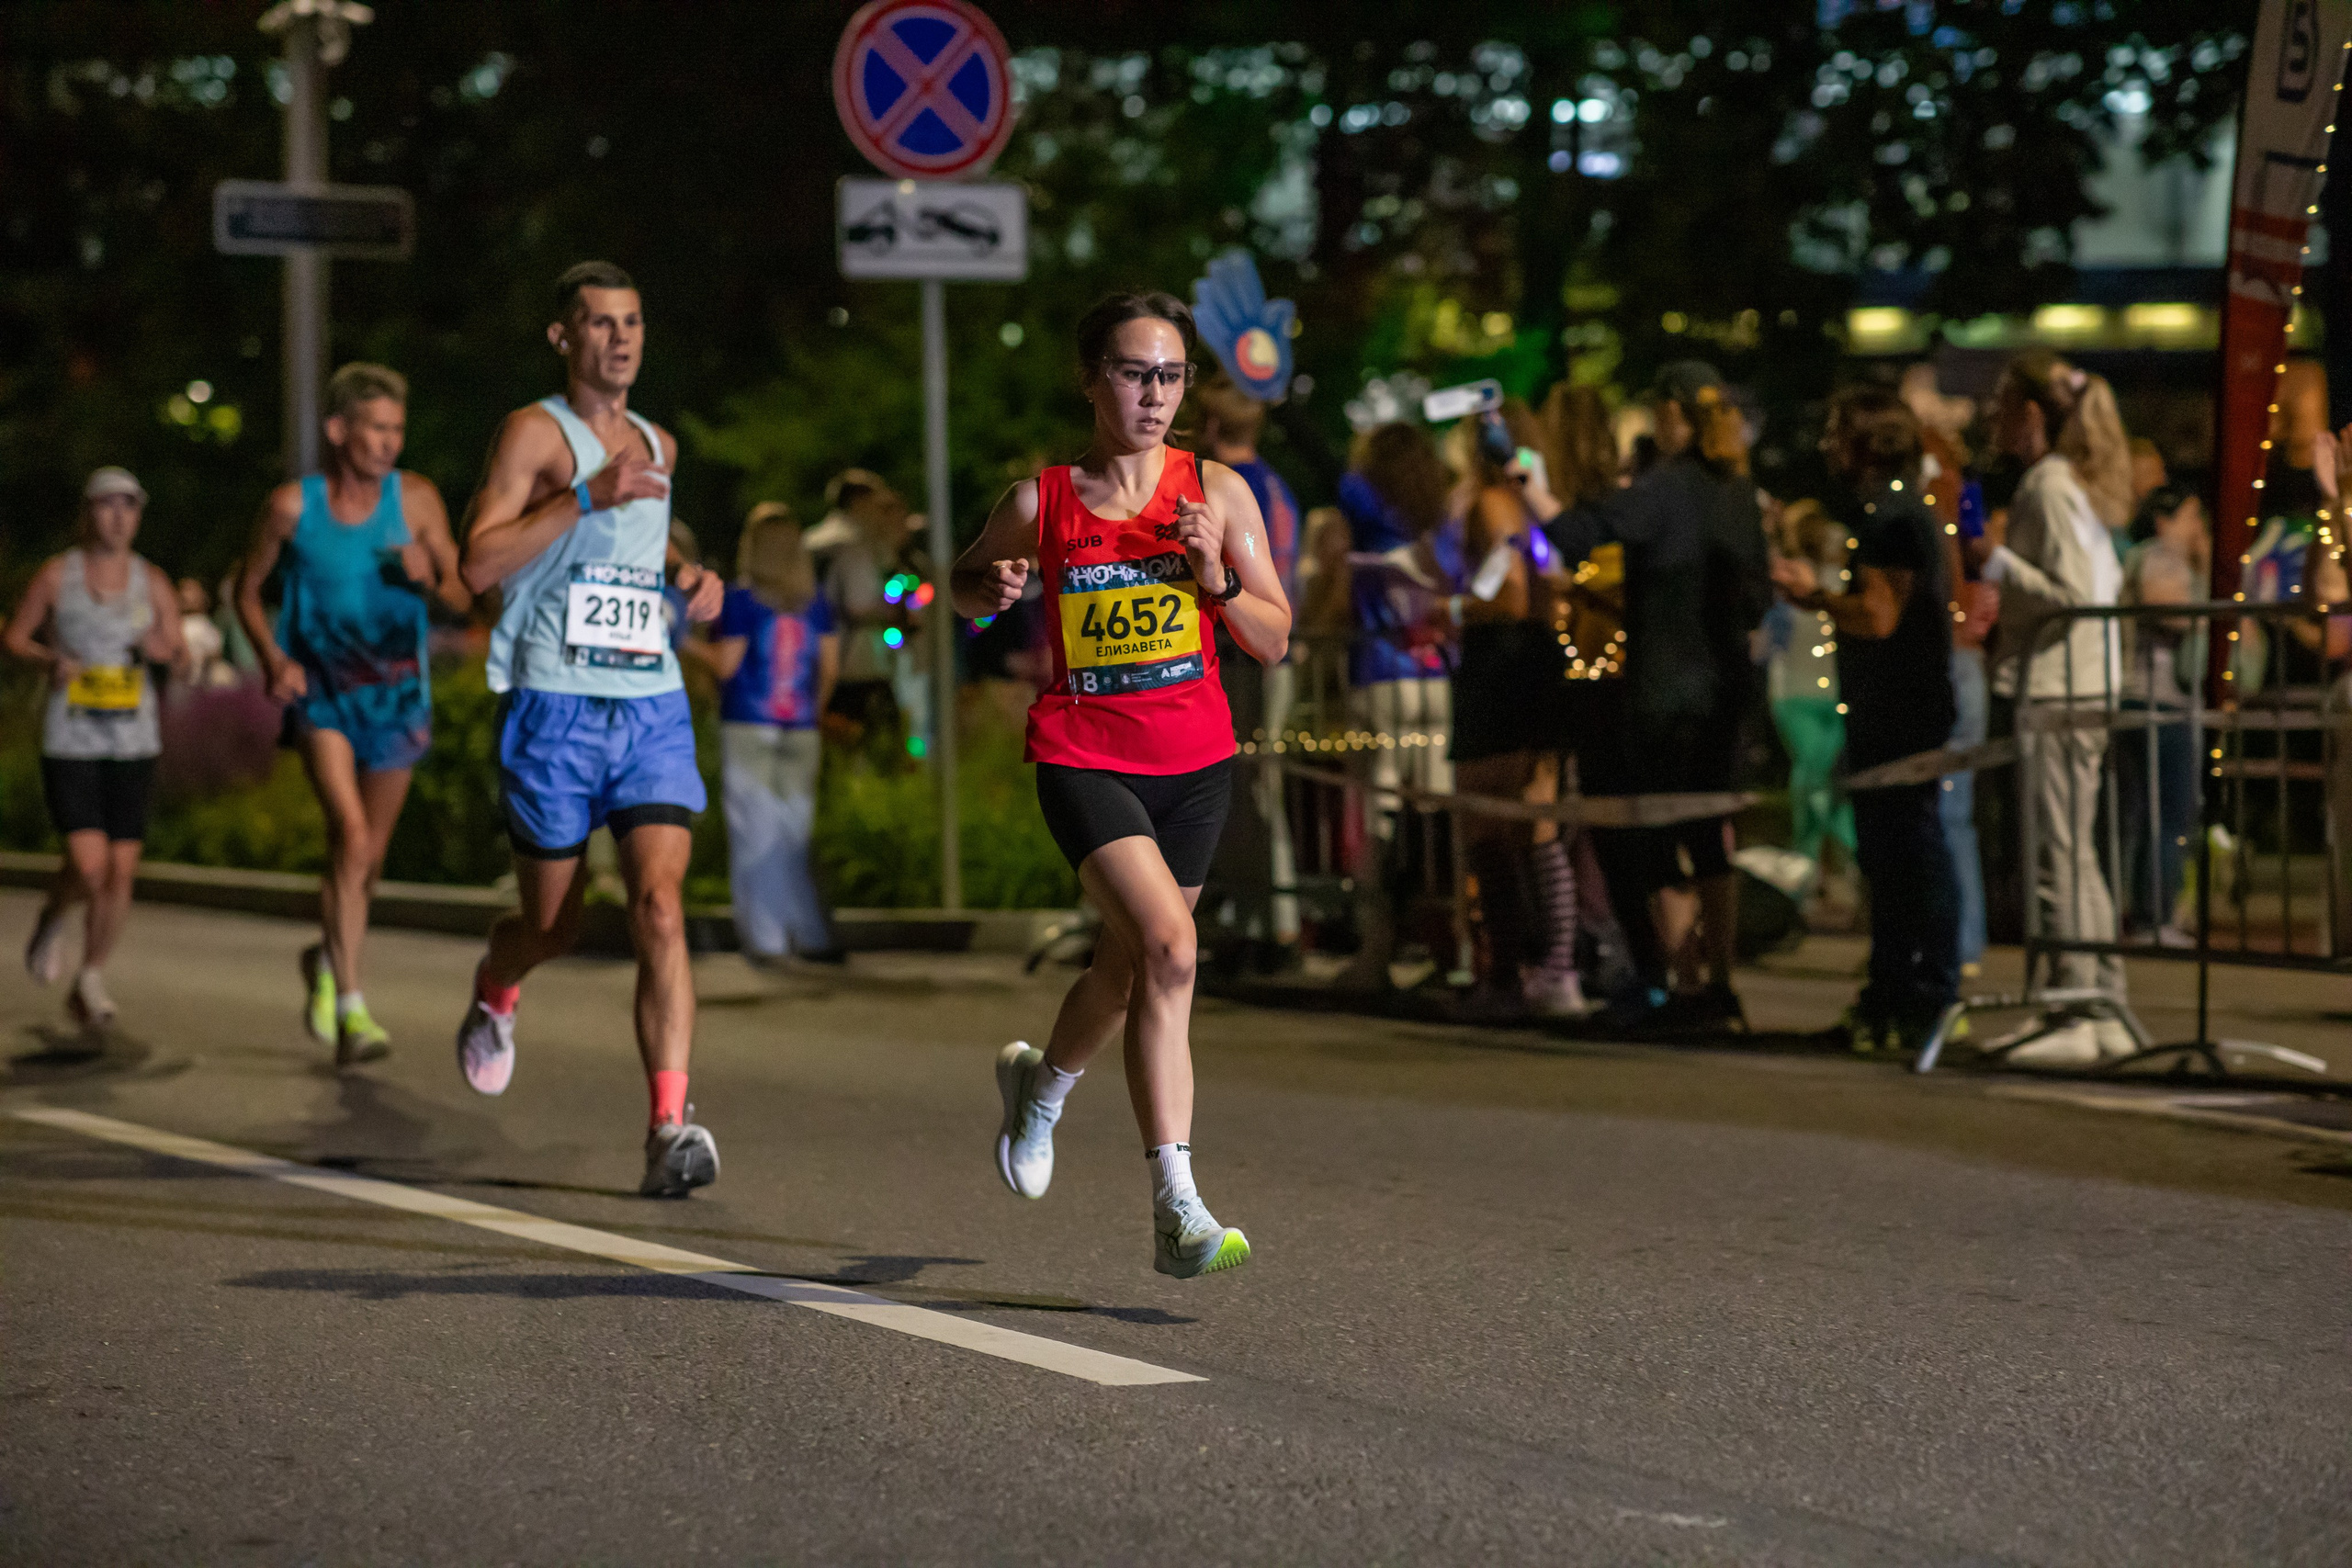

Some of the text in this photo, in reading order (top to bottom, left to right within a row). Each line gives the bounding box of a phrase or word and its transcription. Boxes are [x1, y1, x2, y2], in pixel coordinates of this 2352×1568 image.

[1066, 535, 1103, 552] SUB
[584, 594, 650, 631] 2319
[1080, 593, 1184, 642] 4652
[1096, 637, 1172, 658] ЕЛИЗАВЕТА
